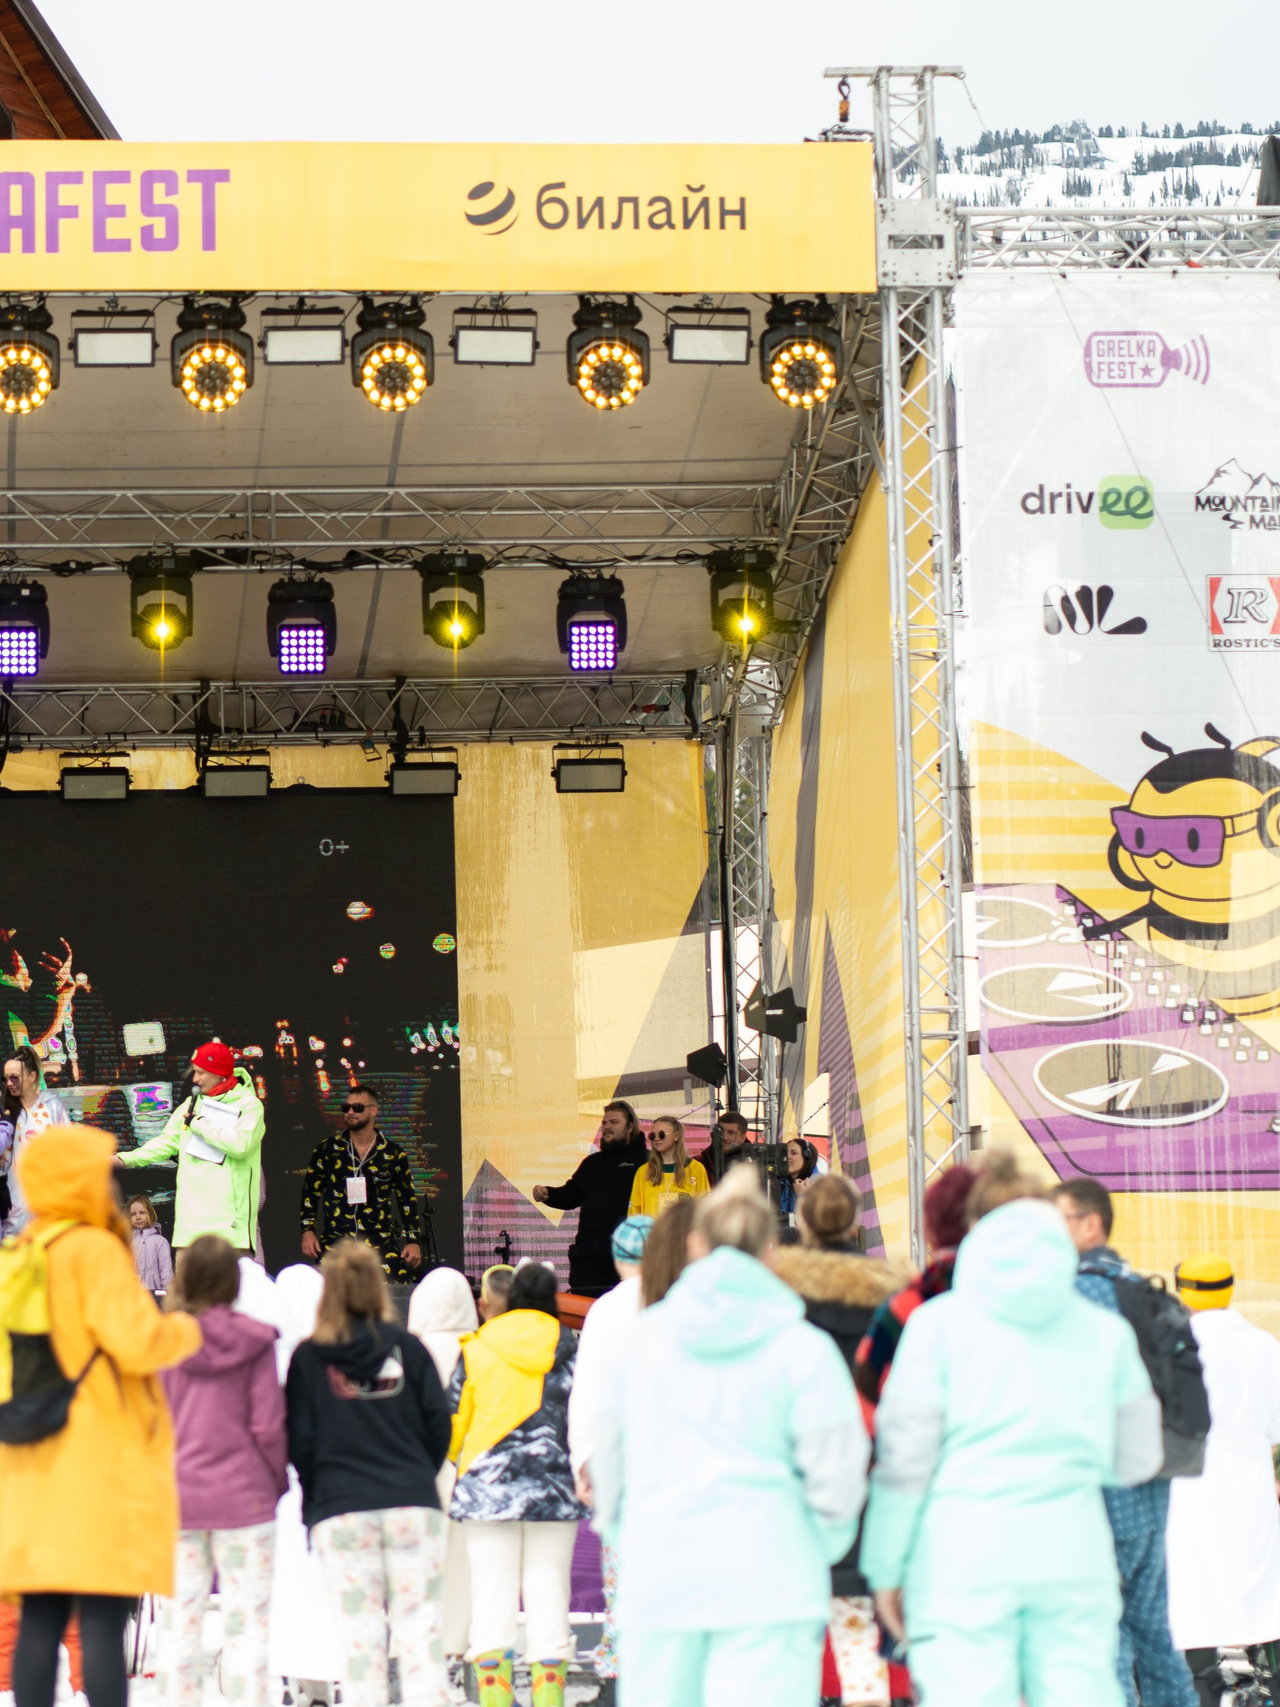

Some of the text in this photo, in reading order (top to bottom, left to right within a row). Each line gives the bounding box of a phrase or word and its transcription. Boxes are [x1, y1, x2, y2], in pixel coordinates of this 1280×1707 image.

[536, 181, 747, 230] билайн
[1096, 339, 1157, 358] GRELKA
[1096, 361, 1138, 380] FEST
[1020, 483, 1155, 520] drivee
[1195, 495, 1280, 512] MOUNTAI
[319, 838, 350, 857] 0+
